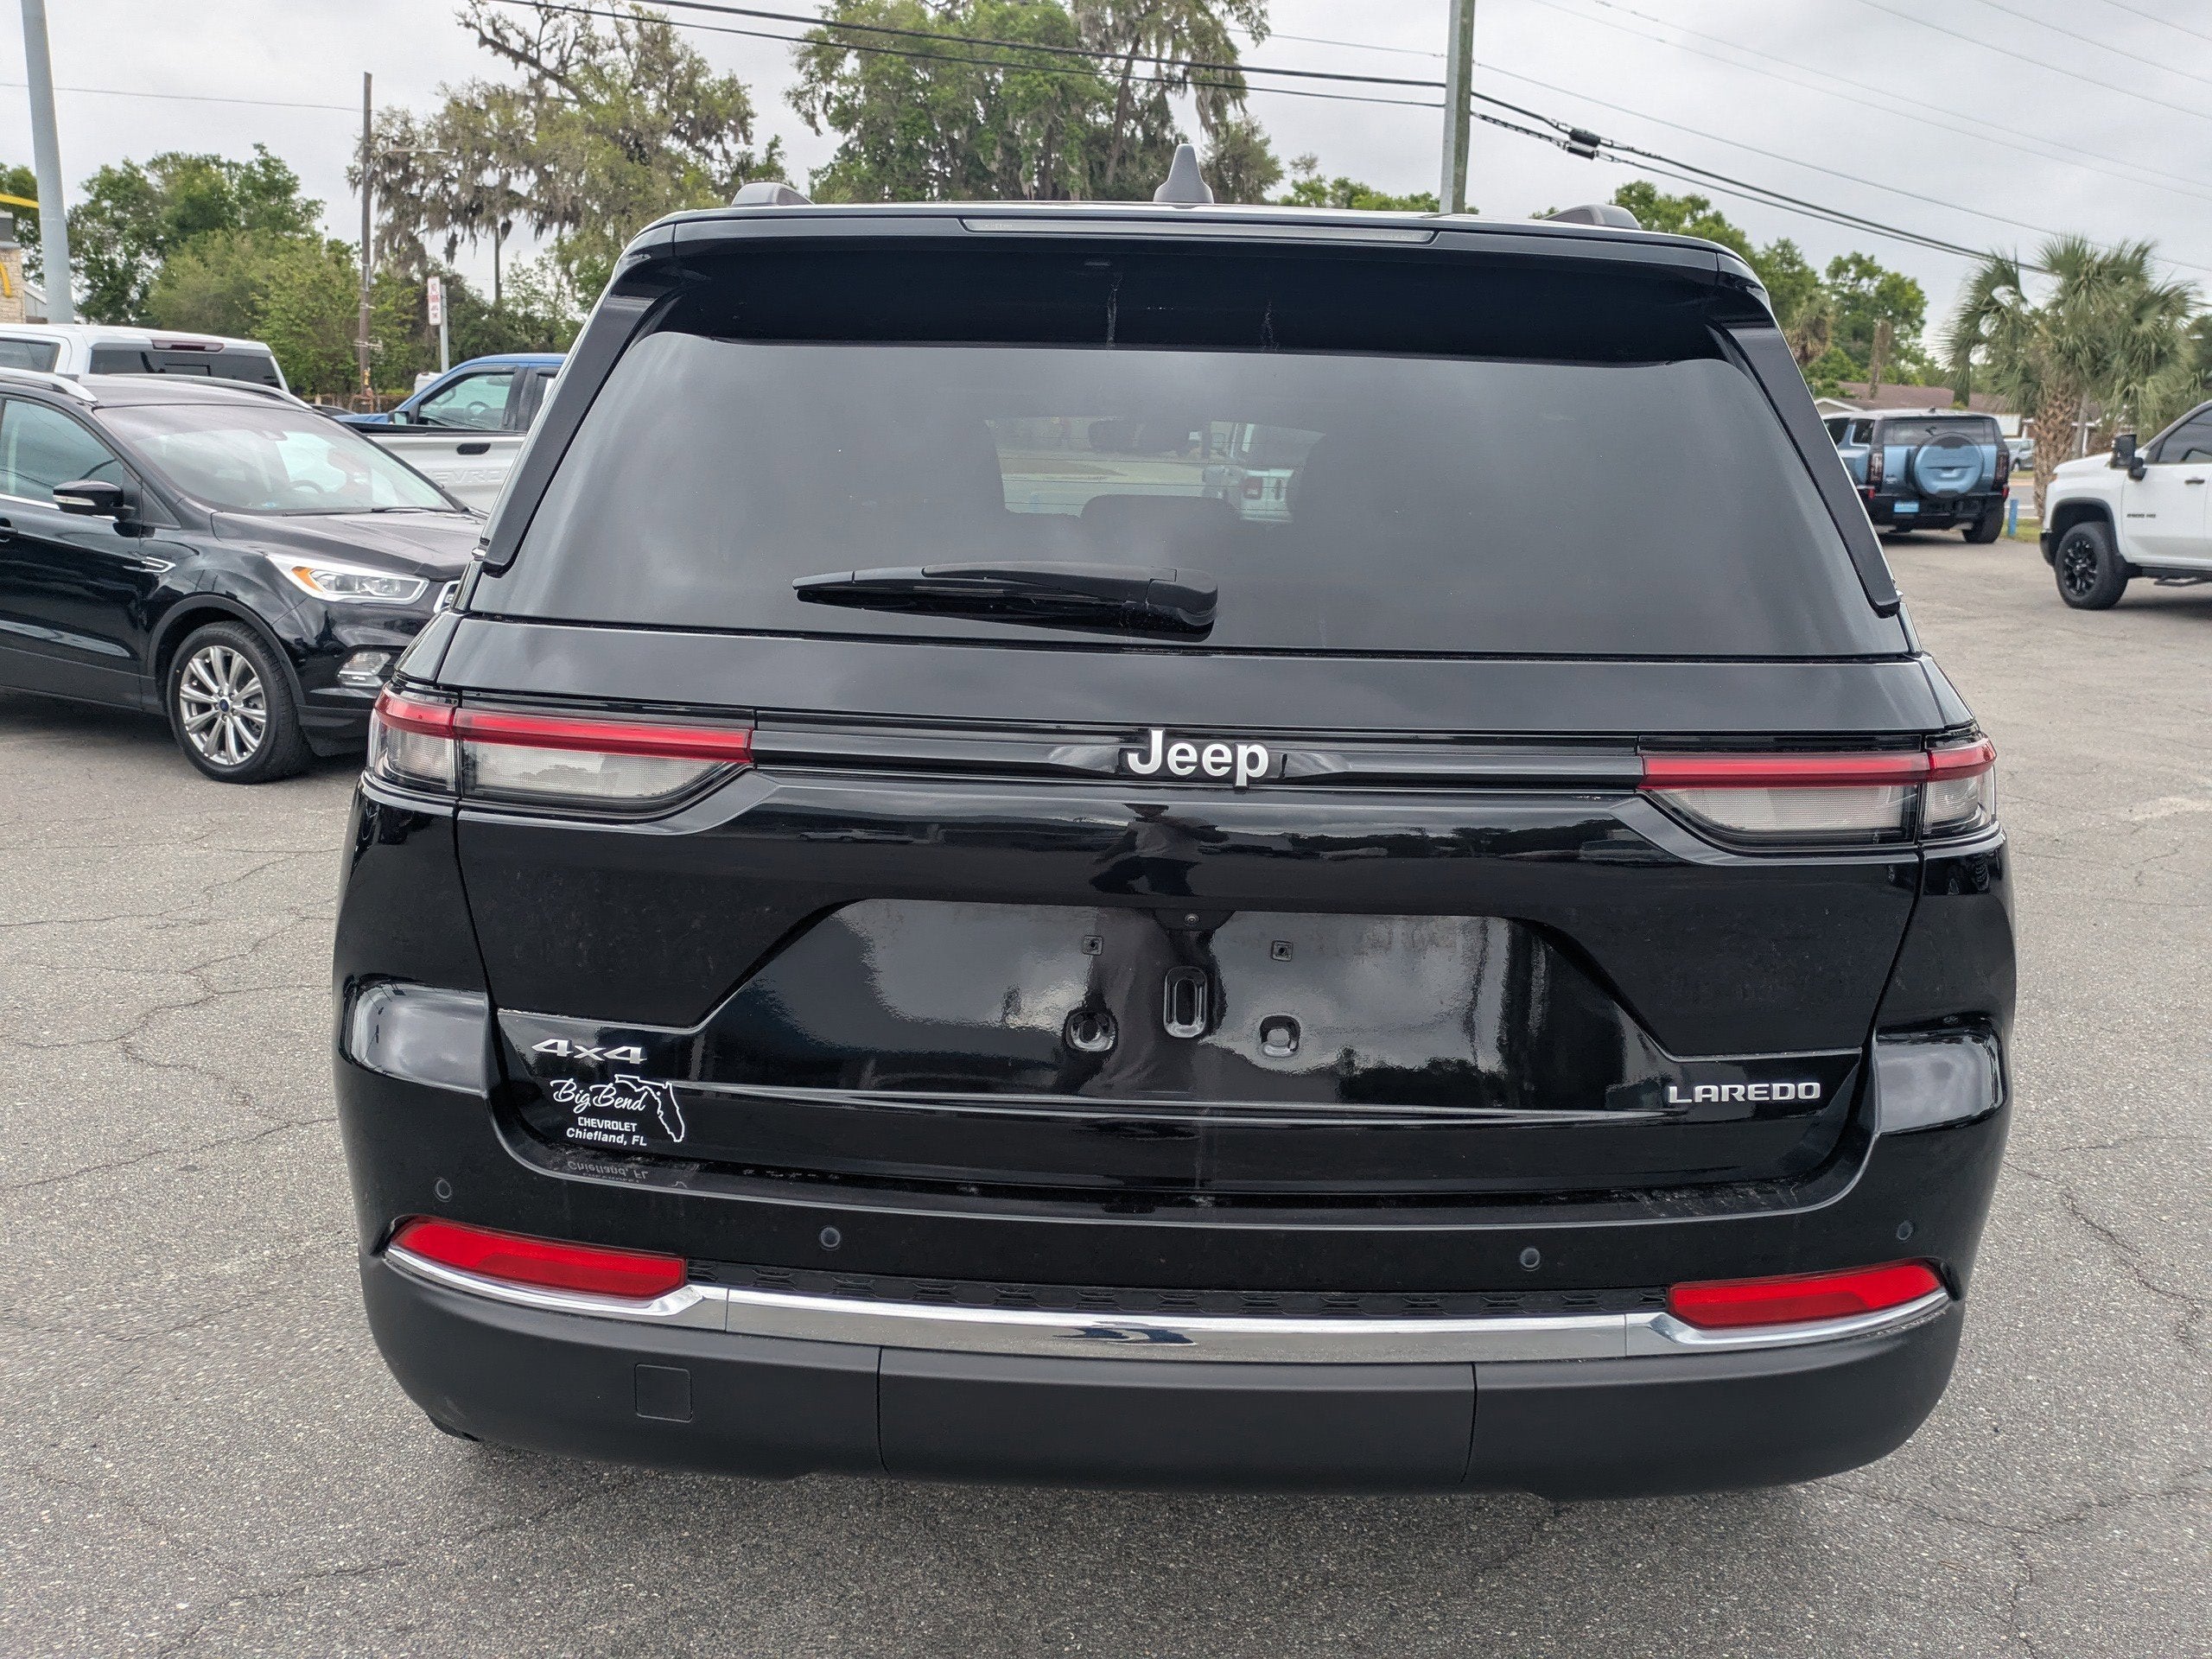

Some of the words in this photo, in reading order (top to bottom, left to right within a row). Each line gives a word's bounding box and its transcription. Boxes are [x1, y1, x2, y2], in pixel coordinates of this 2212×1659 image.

[1127, 729, 1269, 787] Jeep
[531, 1039, 647, 1065] 4x4
[550, 1078, 591, 1114] Big
[589, 1083, 647, 1112] Bend
[1669, 1082, 1821, 1103] LAREDO
[577, 1116, 638, 1133] CHEVROLET
[566, 1127, 627, 1146] Chiefland,
[632, 1136, 647, 1147] FL
